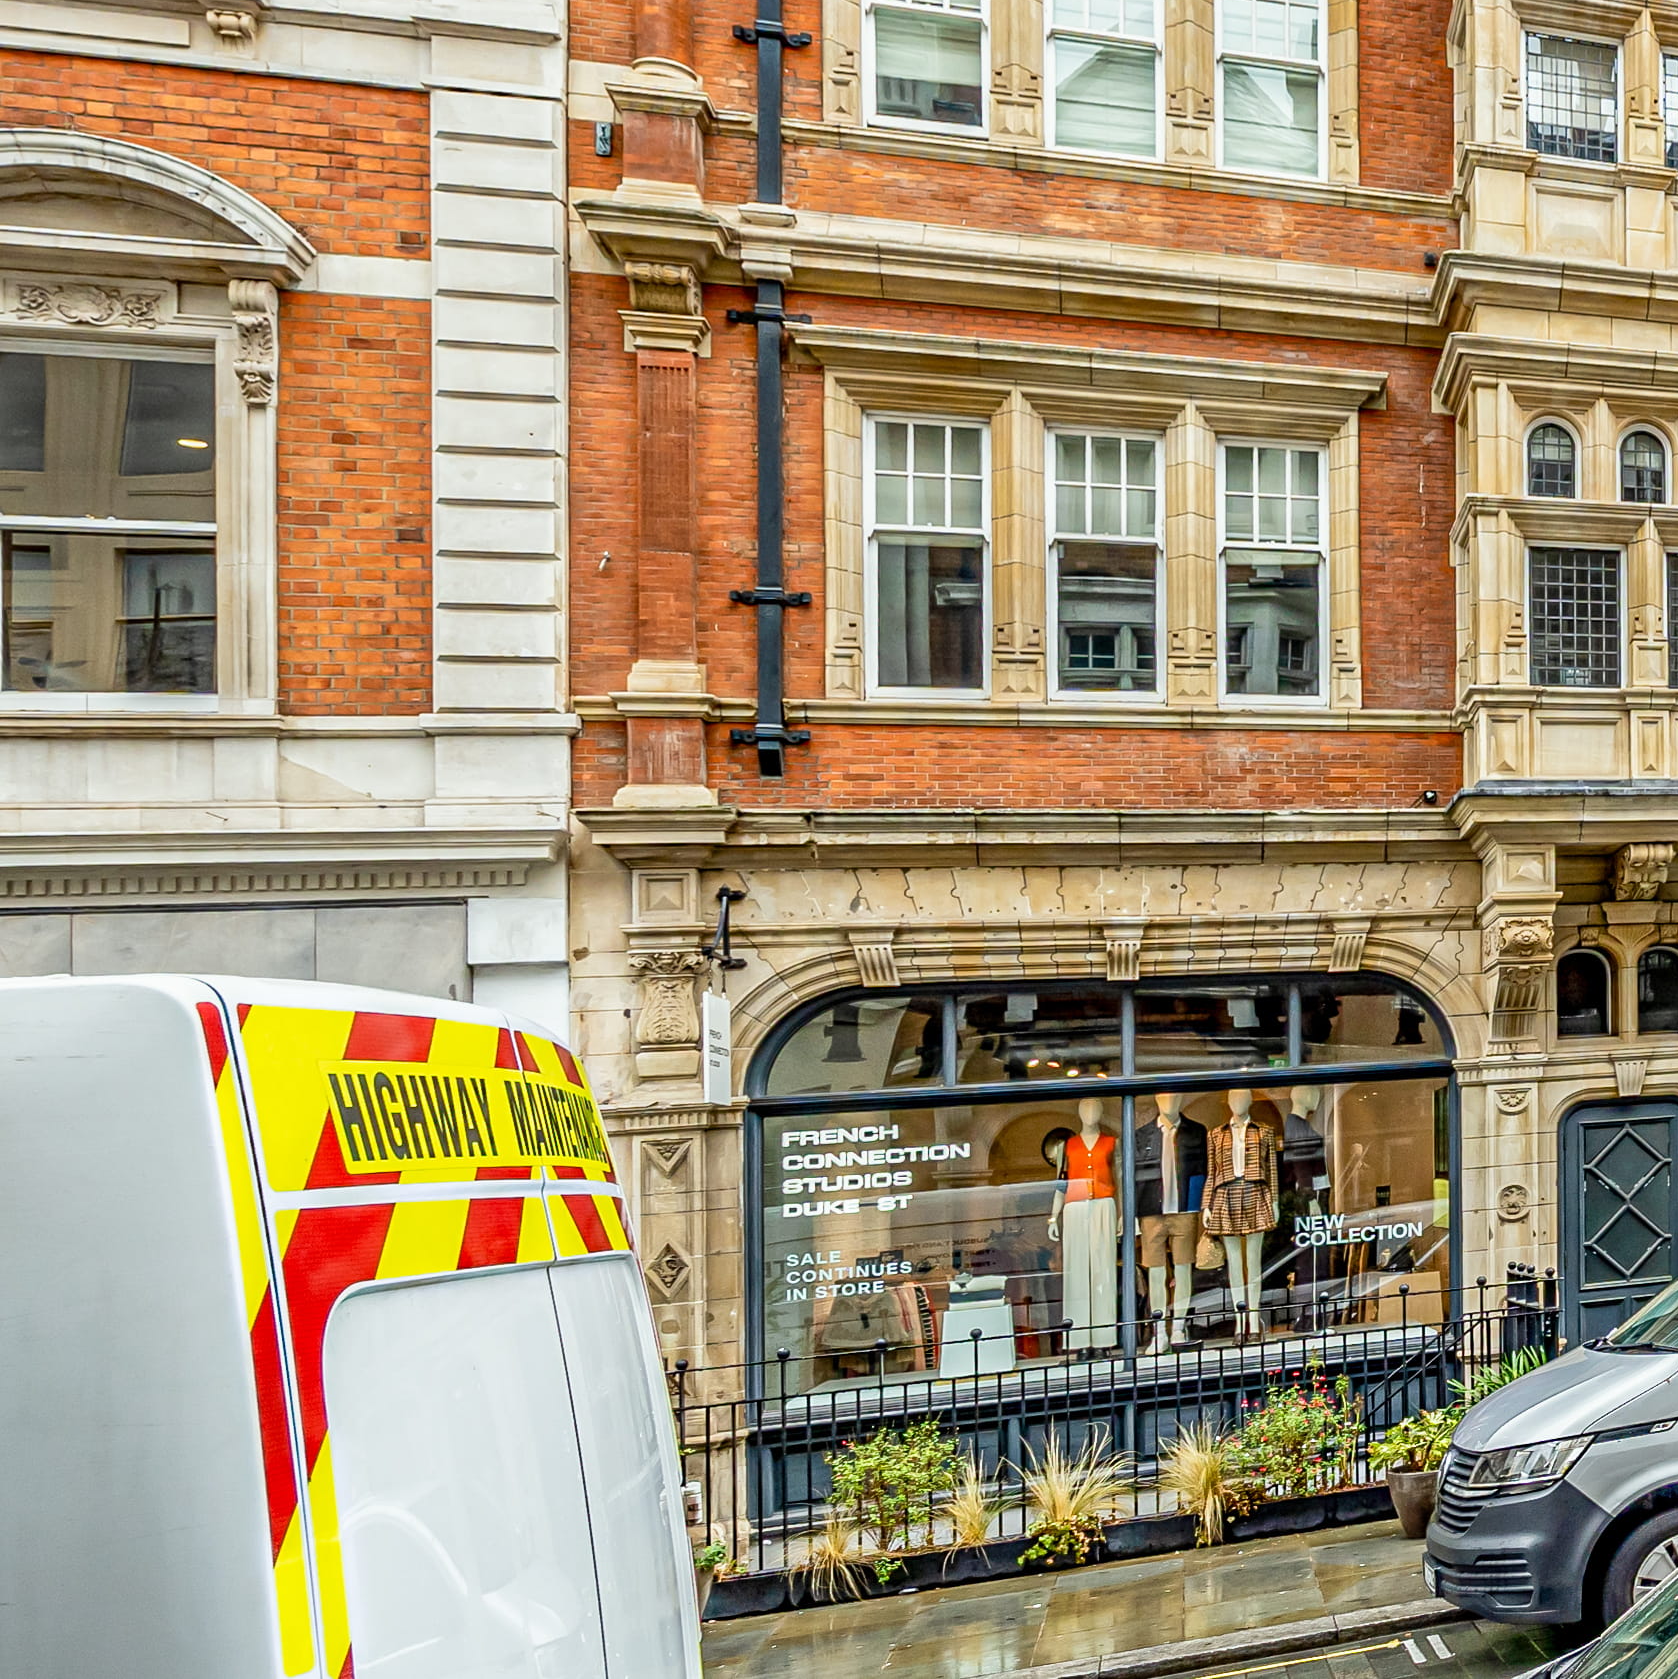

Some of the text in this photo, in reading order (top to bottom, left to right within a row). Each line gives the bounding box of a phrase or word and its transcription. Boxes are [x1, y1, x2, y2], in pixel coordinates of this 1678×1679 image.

[328, 1072, 498, 1162] HIGHWAY
[781, 1124, 899, 1148] FRENCH
[782, 1142, 971, 1171] CONNECTION
[782, 1170, 913, 1195] STUDIOS
[783, 1194, 913, 1218] DUKE ST
[1295, 1214, 1344, 1232] NEW
[1295, 1222, 1423, 1247] COLLECTION
[786, 1250, 841, 1267] SALE
[786, 1261, 913, 1284] CONTINUES
[786, 1280, 885, 1301] IN STORE
